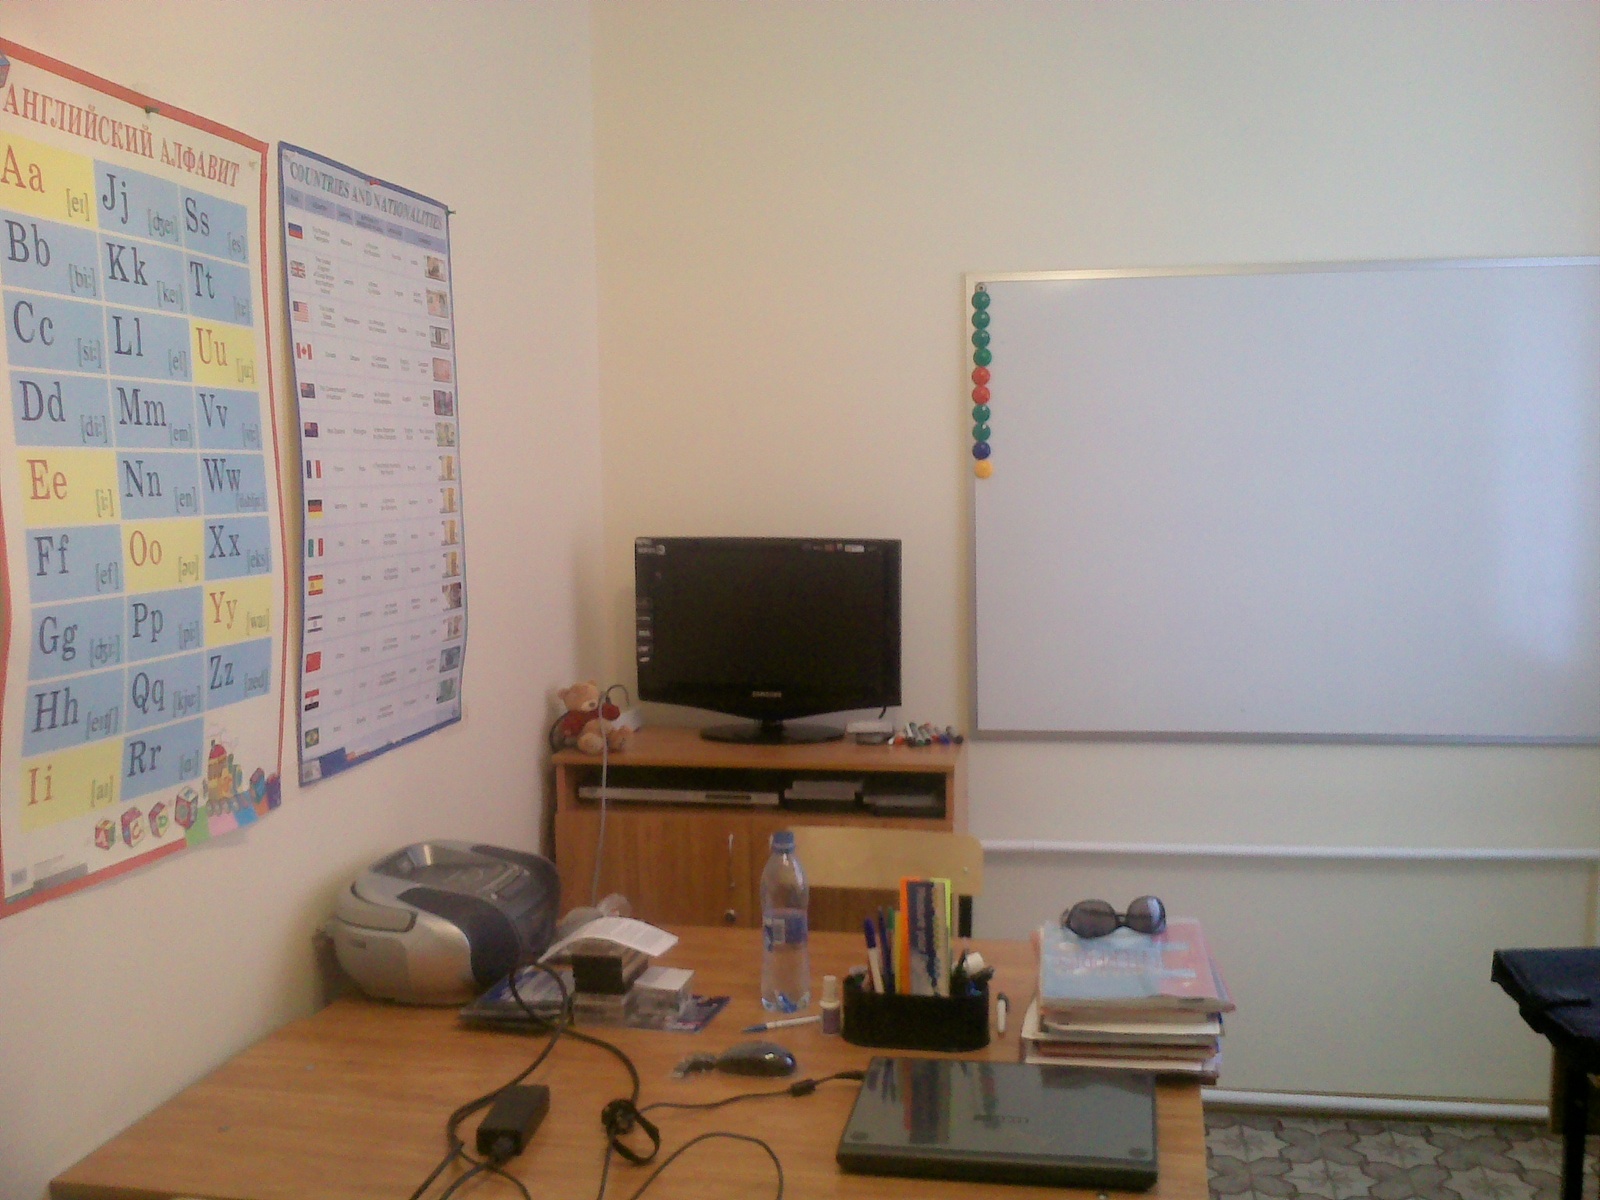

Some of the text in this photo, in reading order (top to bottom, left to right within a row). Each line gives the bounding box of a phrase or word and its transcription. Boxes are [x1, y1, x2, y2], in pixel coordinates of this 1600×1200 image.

[3, 82, 240, 187] АНГЛИЙСКИЙ АЛФАВИТ
[1, 145, 45, 193] Aa
[102, 173, 128, 224] Jj
[185, 197, 210, 236] Ss
[290, 162, 349, 200] COUNTRIES
[352, 185, 372, 207] AND
[373, 193, 443, 231] NATIONALITIES
[5, 220, 50, 267] Bb
[106, 242, 148, 286] Kk
[189, 261, 214, 299] Tt
[13, 301, 54, 345] Cc
[112, 316, 143, 356] Ll
[195, 327, 227, 366] Uu
[19, 380, 66, 422] Dd
[116, 387, 166, 426] Mm
[199, 393, 228, 428] Vv
[26, 459, 67, 499] Ee
[122, 460, 162, 497] Nn
[203, 458, 241, 492] Ww
[34, 534, 69, 576] Ff
[129, 530, 162, 567] Oo
[208, 525, 241, 558] Xx
[132, 603, 163, 642] Pp
[209, 591, 238, 630] Yy
[39, 616, 78, 661] Gg
[210, 655, 234, 690] Zz
[31, 687, 79, 733] Hh
[132, 672, 165, 714] Qq
[127, 740, 161, 777] Rr
[27, 765, 53, 806] Ii
